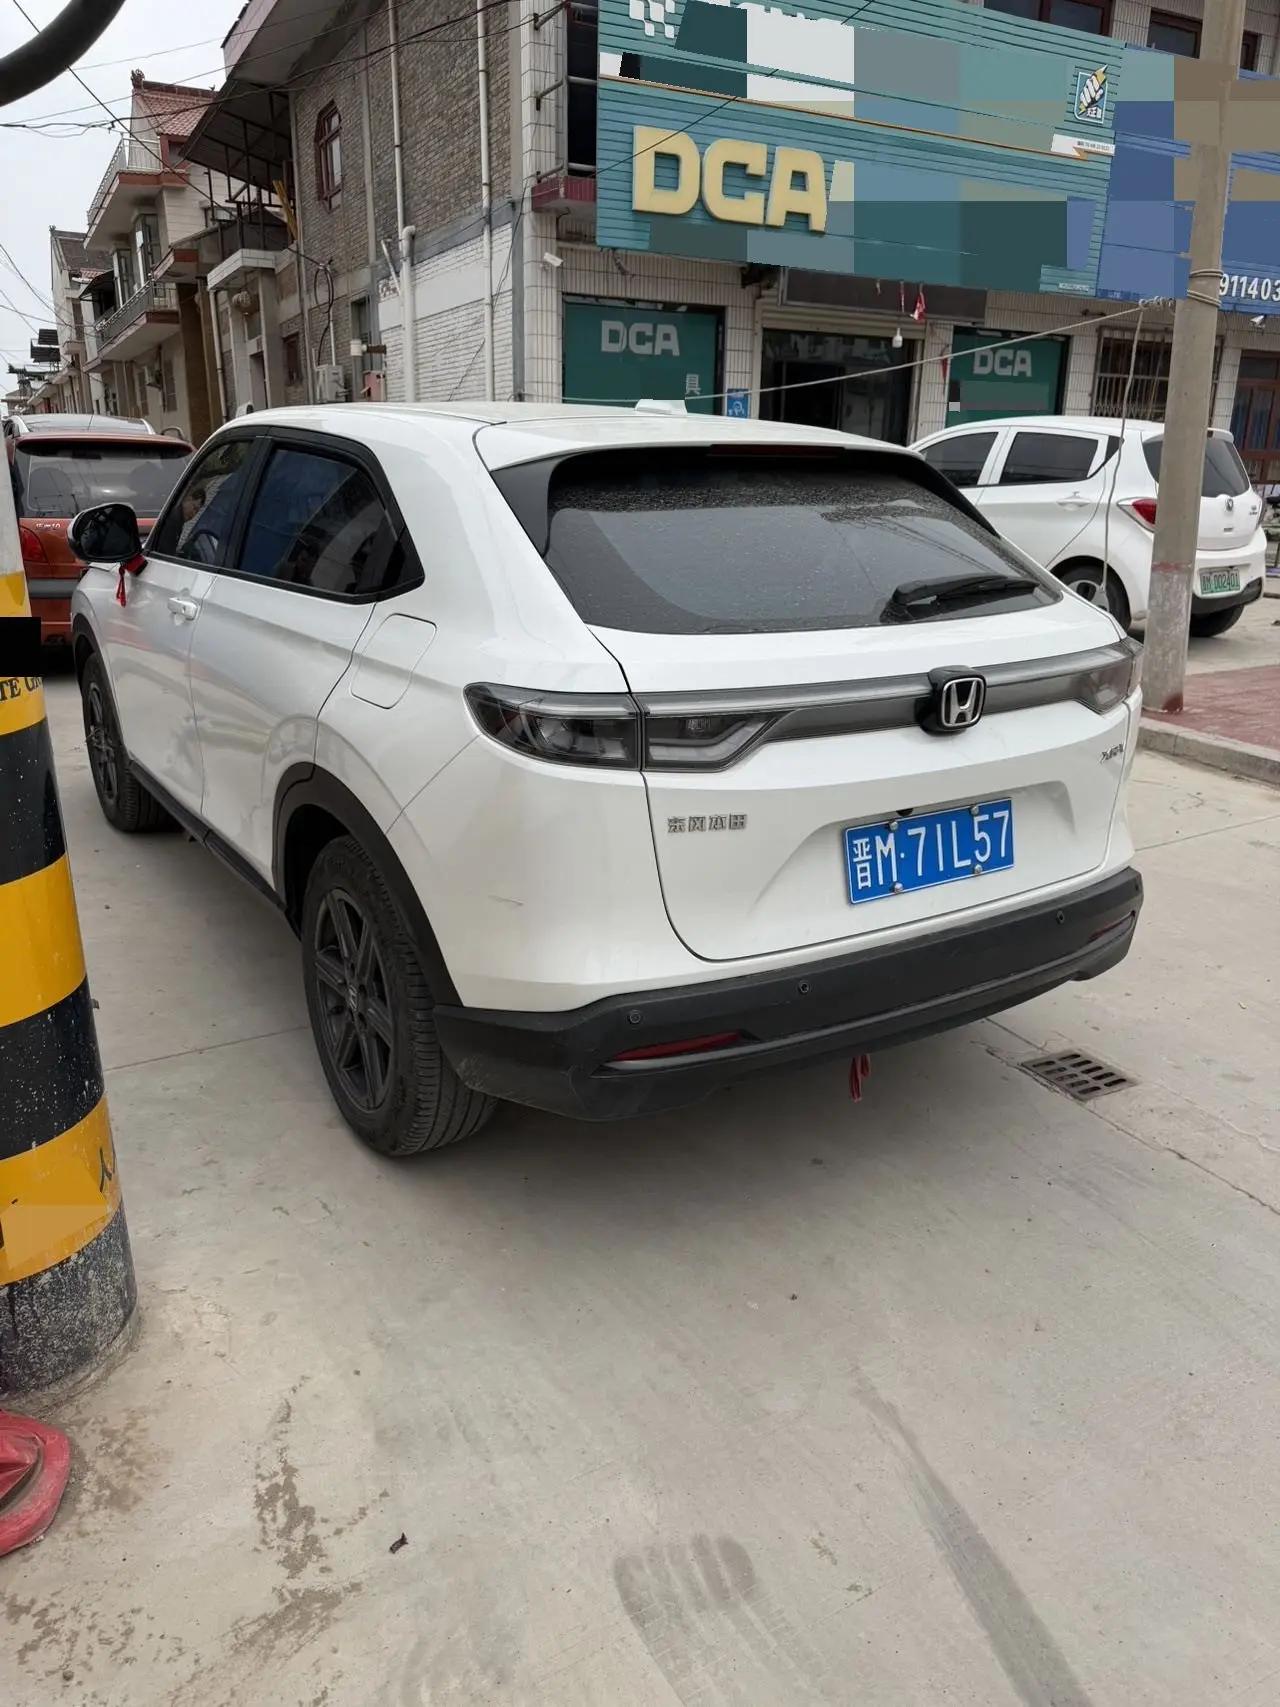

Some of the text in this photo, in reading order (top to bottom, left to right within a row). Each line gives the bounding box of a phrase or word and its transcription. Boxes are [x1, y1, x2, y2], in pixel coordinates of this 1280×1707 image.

[632, 125, 829, 234] DCA
[601, 319, 680, 357] DCA
[972, 348, 1033, 378] DCA
[685, 373, 702, 395] 具
[667, 813, 747, 833] 东风本田
